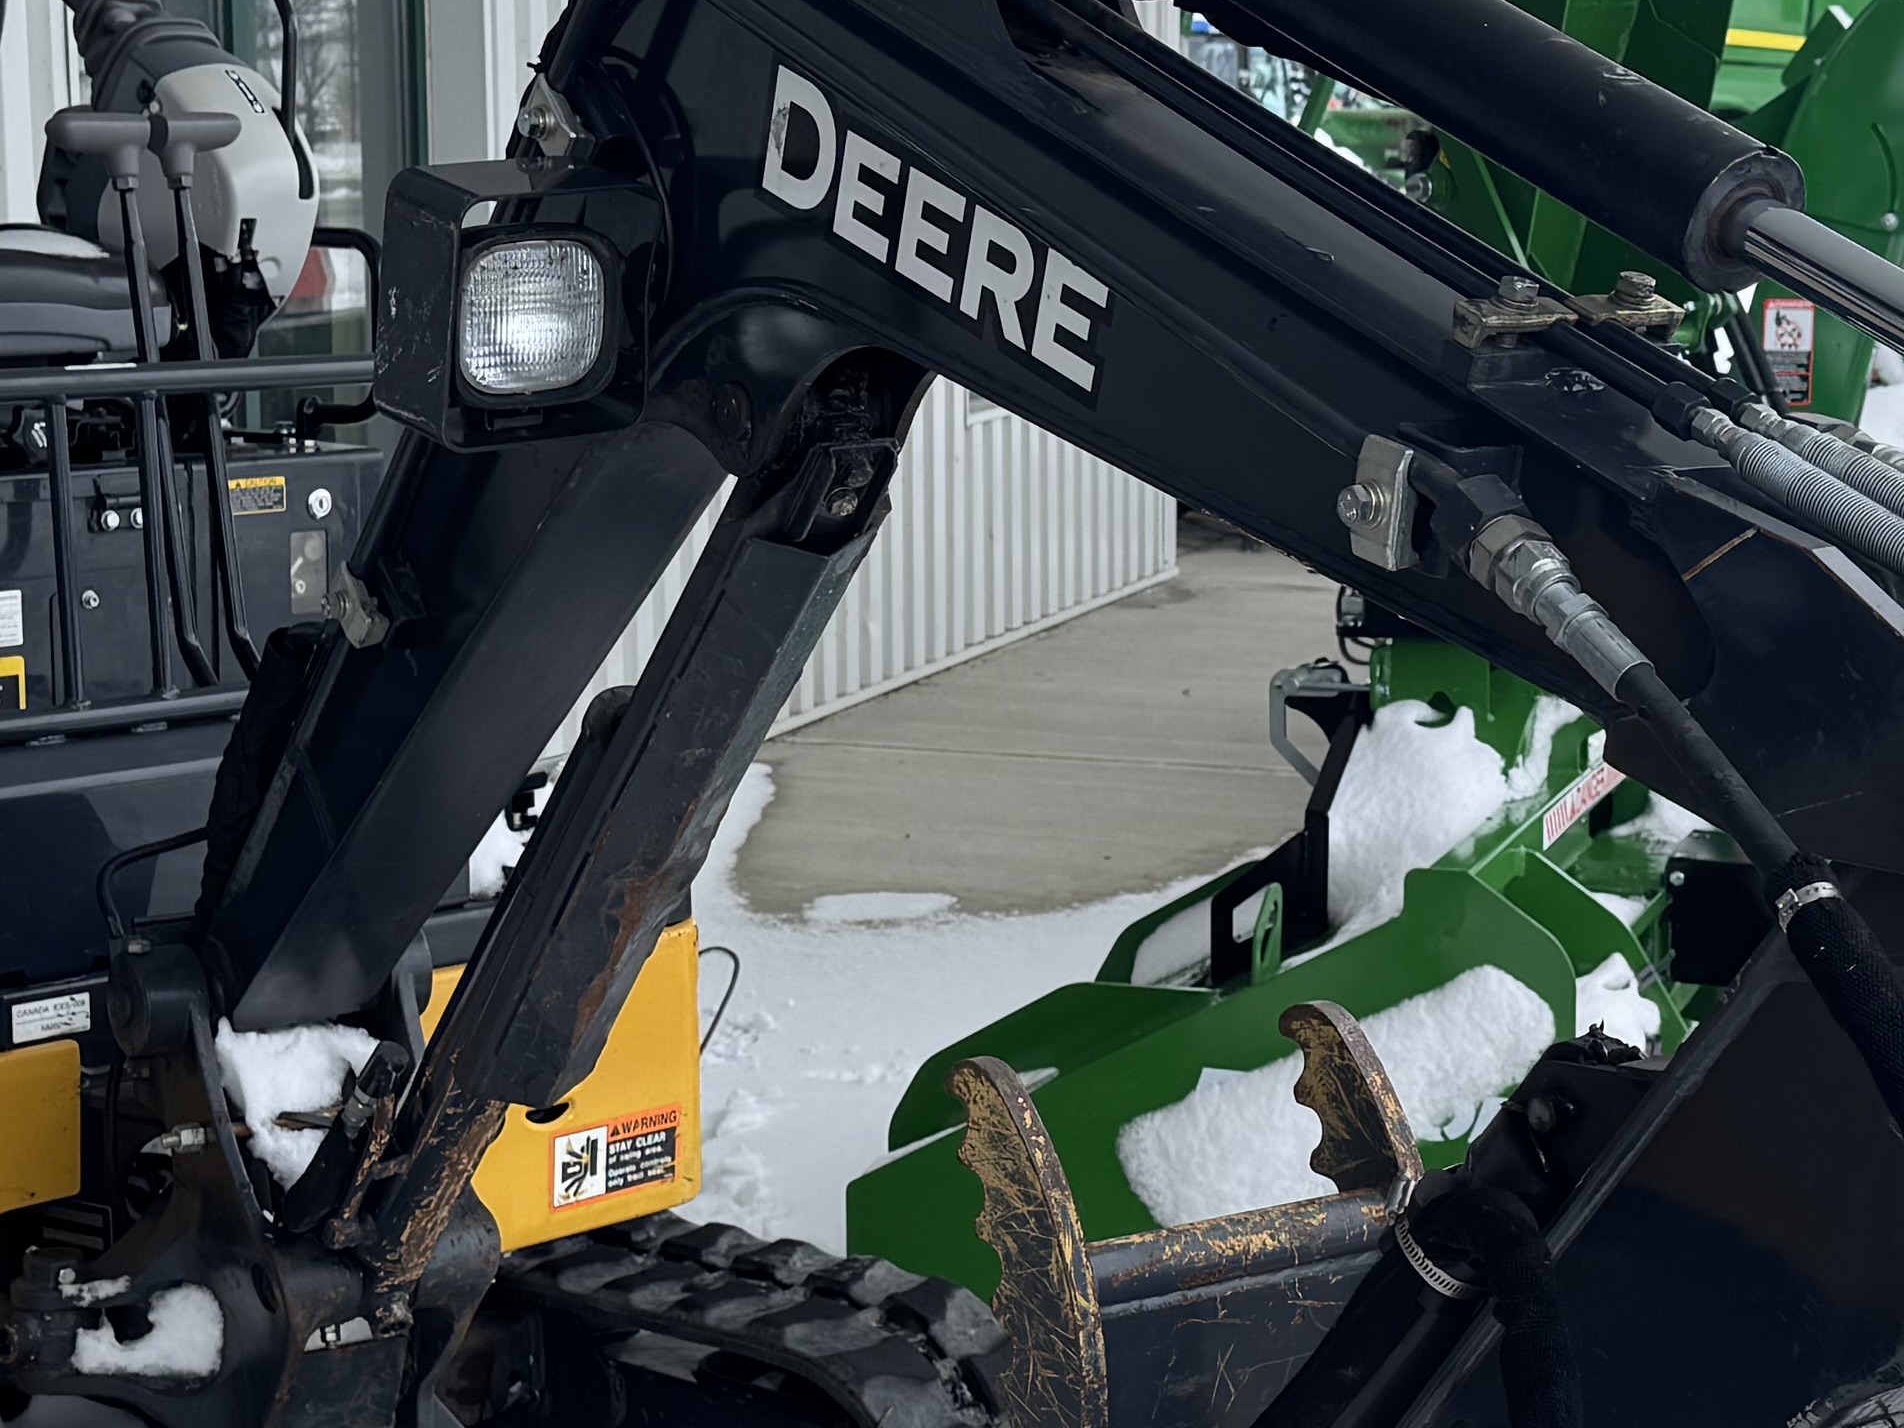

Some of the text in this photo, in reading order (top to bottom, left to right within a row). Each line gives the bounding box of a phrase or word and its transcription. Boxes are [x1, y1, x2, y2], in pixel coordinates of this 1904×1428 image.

[761, 64, 1111, 394] DEERE
[621, 1110, 677, 1134] WARNING
[608, 1131, 667, 1155] STAY CLEAR
